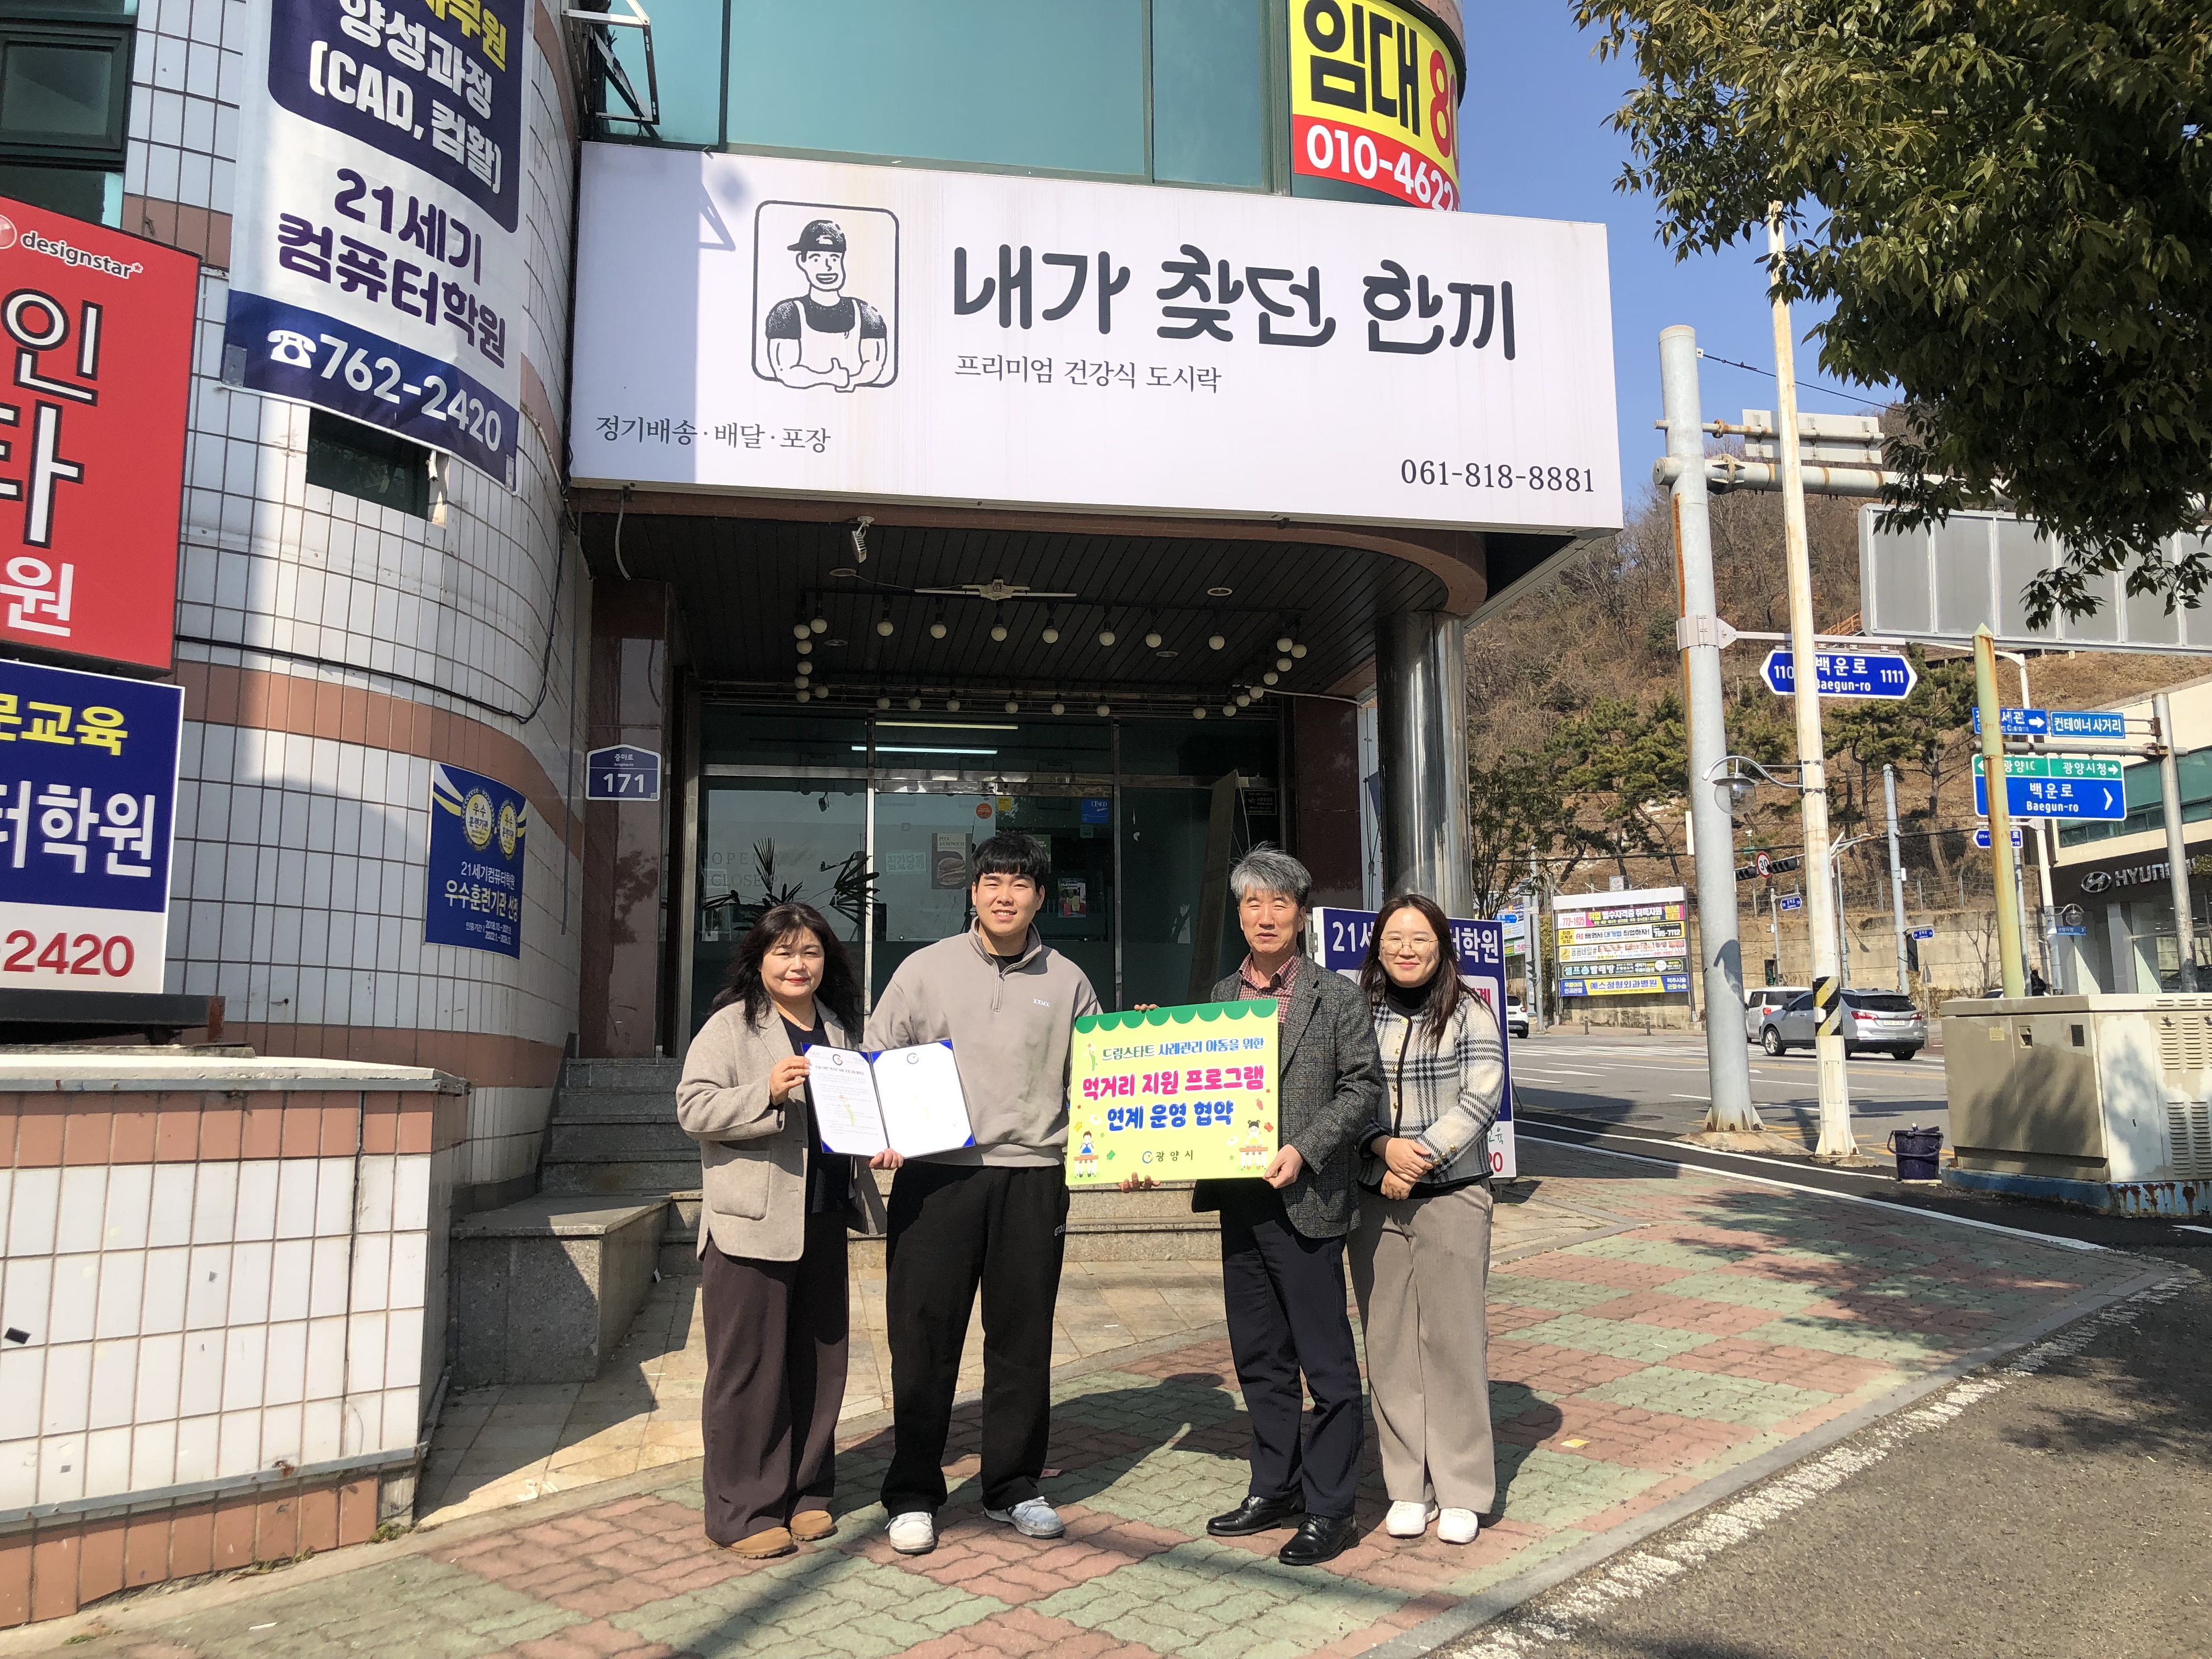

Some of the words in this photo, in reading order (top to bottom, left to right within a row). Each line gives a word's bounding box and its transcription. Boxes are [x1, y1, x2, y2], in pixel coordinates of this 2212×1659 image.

[1304, 0, 1420, 137] 임대
[334, 168, 482, 285] 21세기
[20, 230, 133, 279] designstar
[278, 212, 506, 369] 컴퓨터학원
[953, 244, 1131, 335] 내가
[1156, 244, 1336, 348] 찾던
[1363, 259, 1516, 360] 한끼
[955, 354, 1052, 383] 프리미엄
[1064, 359, 1136, 390] 건강식
[1146, 364, 1222, 393] 도시락
[320, 332, 501, 452] 762-2420
[1401, 459, 1595, 492] 061-818-8881
[1815, 657, 1868, 676] 백운로
[1881, 669, 1904, 684] 1111
[2054, 717, 2091, 732] 컨테이너
[2093, 718, 2121, 733] 사거리
[614, 753, 634, 762] 중마로
[2063, 761, 2107, 776] 광양시청
[603, 772, 644, 793] 171
[2030, 782, 2074, 799] 백운로
[472, 802, 486, 818] 우수
[2026, 800, 2079, 814] Baegun-ro
[1562, 917, 1585, 927] 772-1925
[3, 929, 135, 978] 2420
[1102, 1045, 1155, 1060] 드림스타트
[1158, 1041, 1203, 1056] 사례관리
[1206, 1038, 1239, 1053] 아동을
[1242, 1037, 1265, 1050] 위한
[1083, 1073, 1135, 1101] 먹거리
[1142, 1070, 1179, 1095] 지원
[1184, 1065, 1265, 1091] 프로그램
[1107, 1105, 1144, 1132] 연계
[1150, 1102, 1187, 1128] 운영
[1193, 1100, 1234, 1126] 협약
